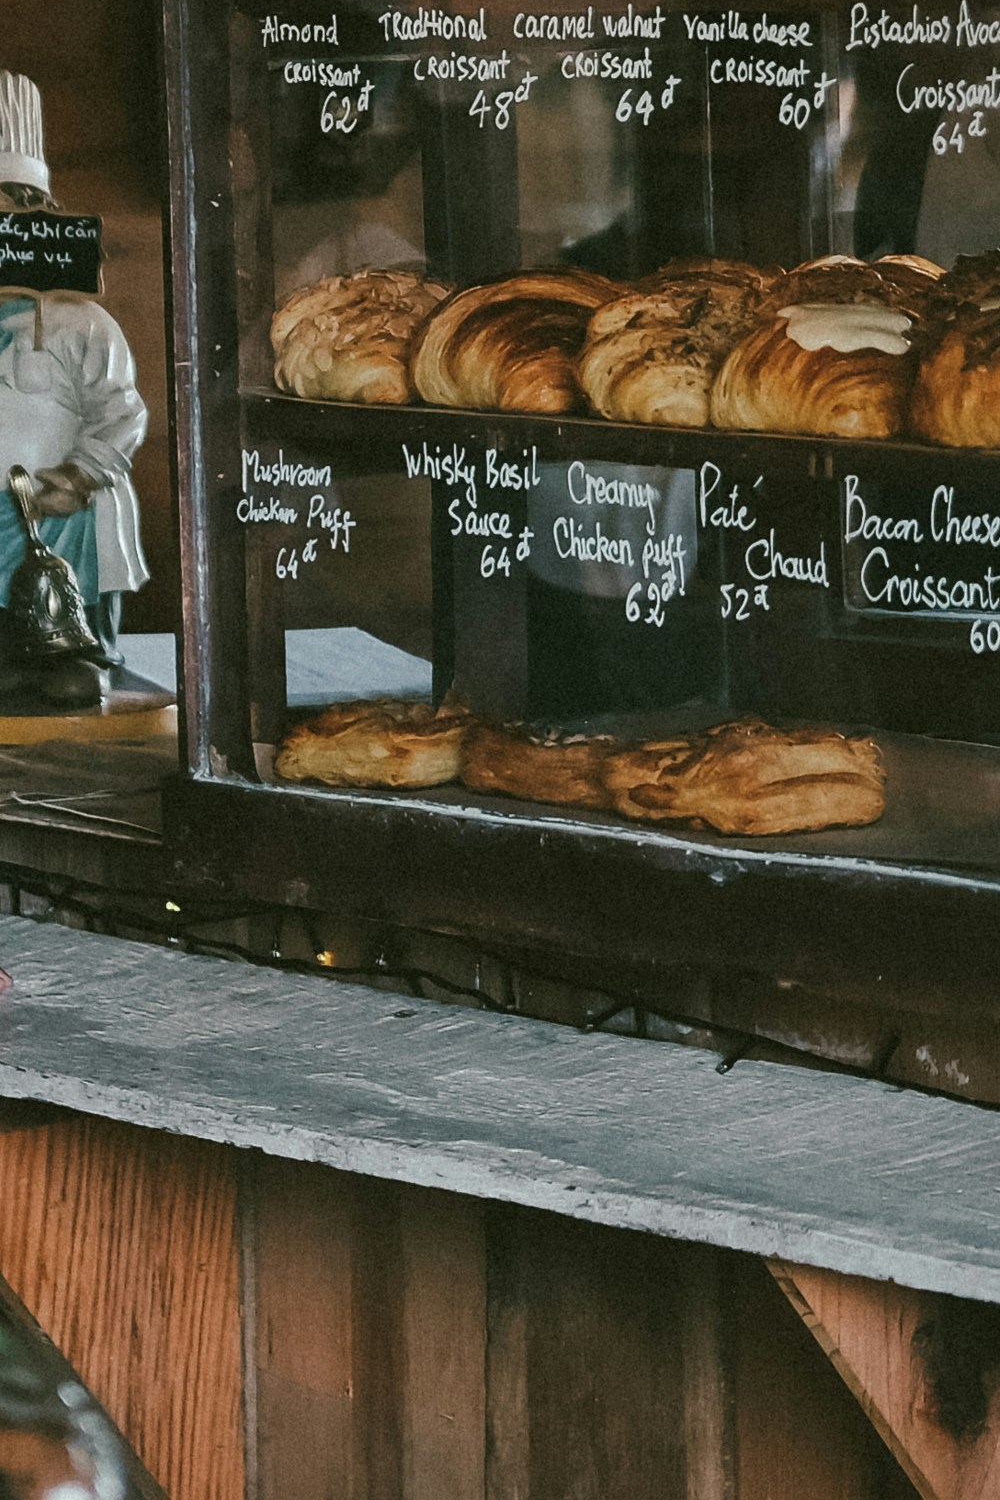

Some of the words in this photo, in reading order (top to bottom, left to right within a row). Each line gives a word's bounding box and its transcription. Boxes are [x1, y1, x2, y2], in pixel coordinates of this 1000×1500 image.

[261, 13, 339, 47] Almond
[241, 448, 331, 493] Mushroom
[402, 441, 477, 509] Whisky
[486, 445, 540, 490] Basil
[567, 460, 656, 535] Creamy
[236, 497, 298, 525] Chicken
[448, 498, 513, 538] Sauce
[844, 474, 923, 544] Bacon
[553, 516, 634, 567] Chicken
[745, 528, 830, 588] Chaud
[860, 546, 1000, 610] Croissant
